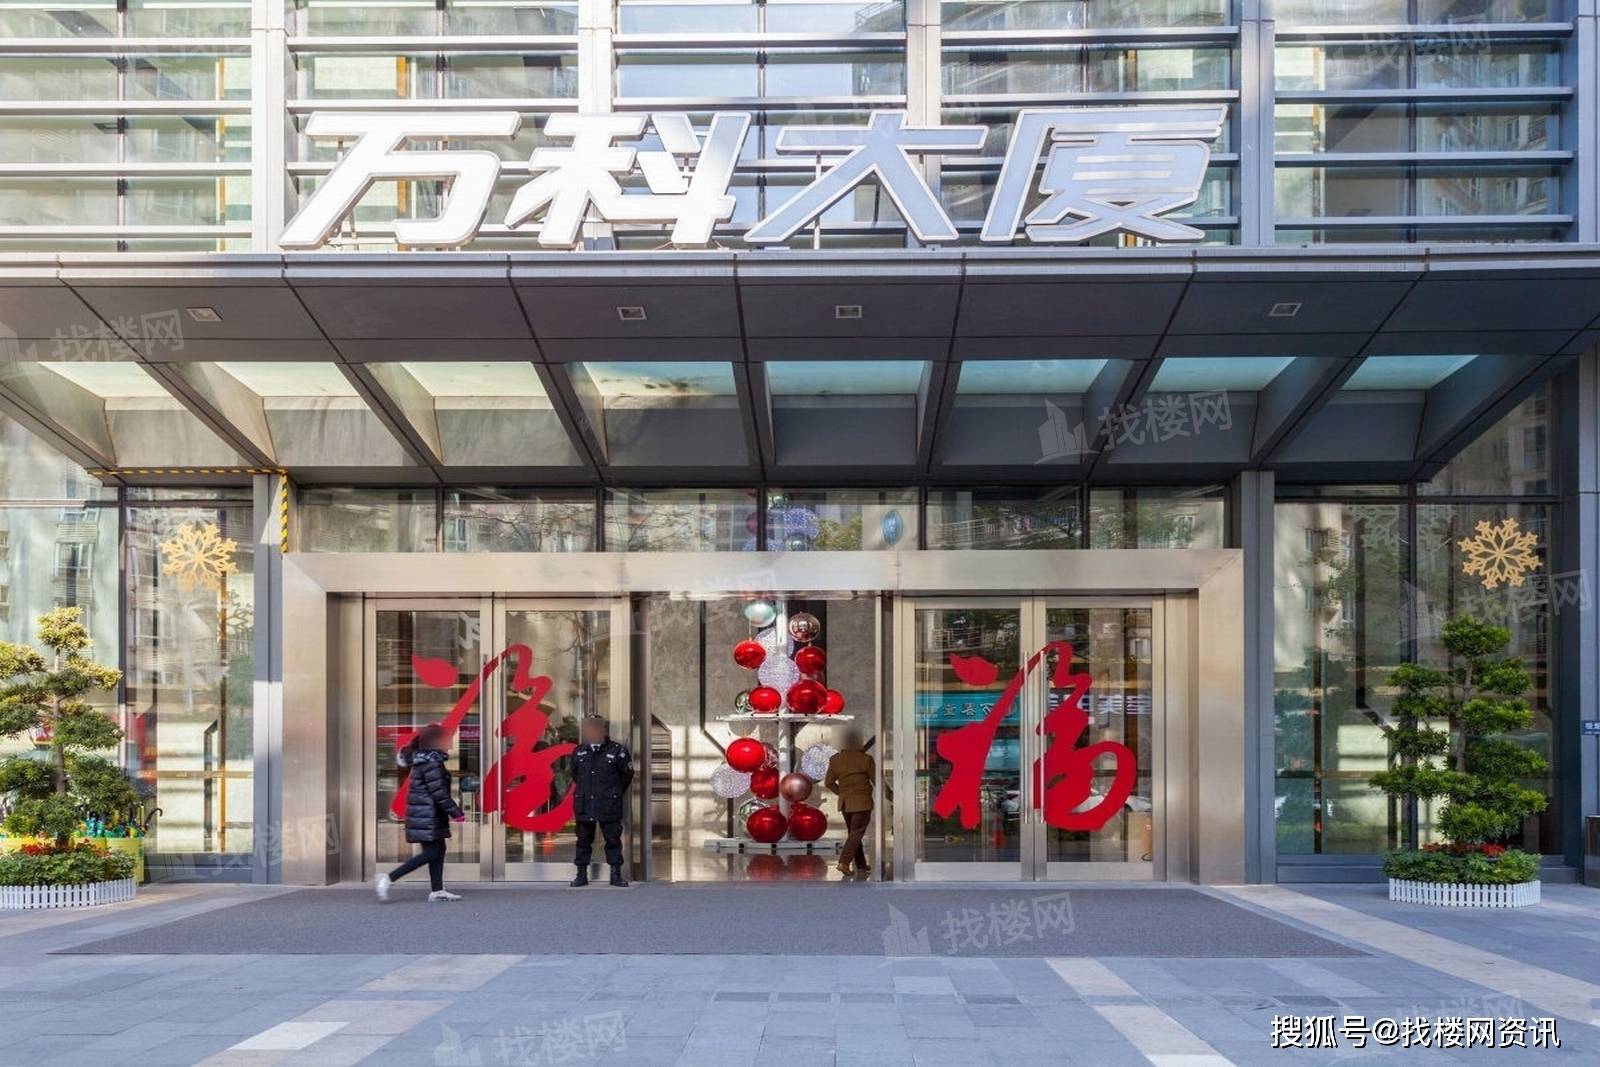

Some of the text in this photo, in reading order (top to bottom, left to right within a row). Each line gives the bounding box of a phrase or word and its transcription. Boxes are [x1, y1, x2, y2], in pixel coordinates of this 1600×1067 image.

[278, 106, 1227, 248] 万科大厦
[934, 641, 1136, 831] 福
